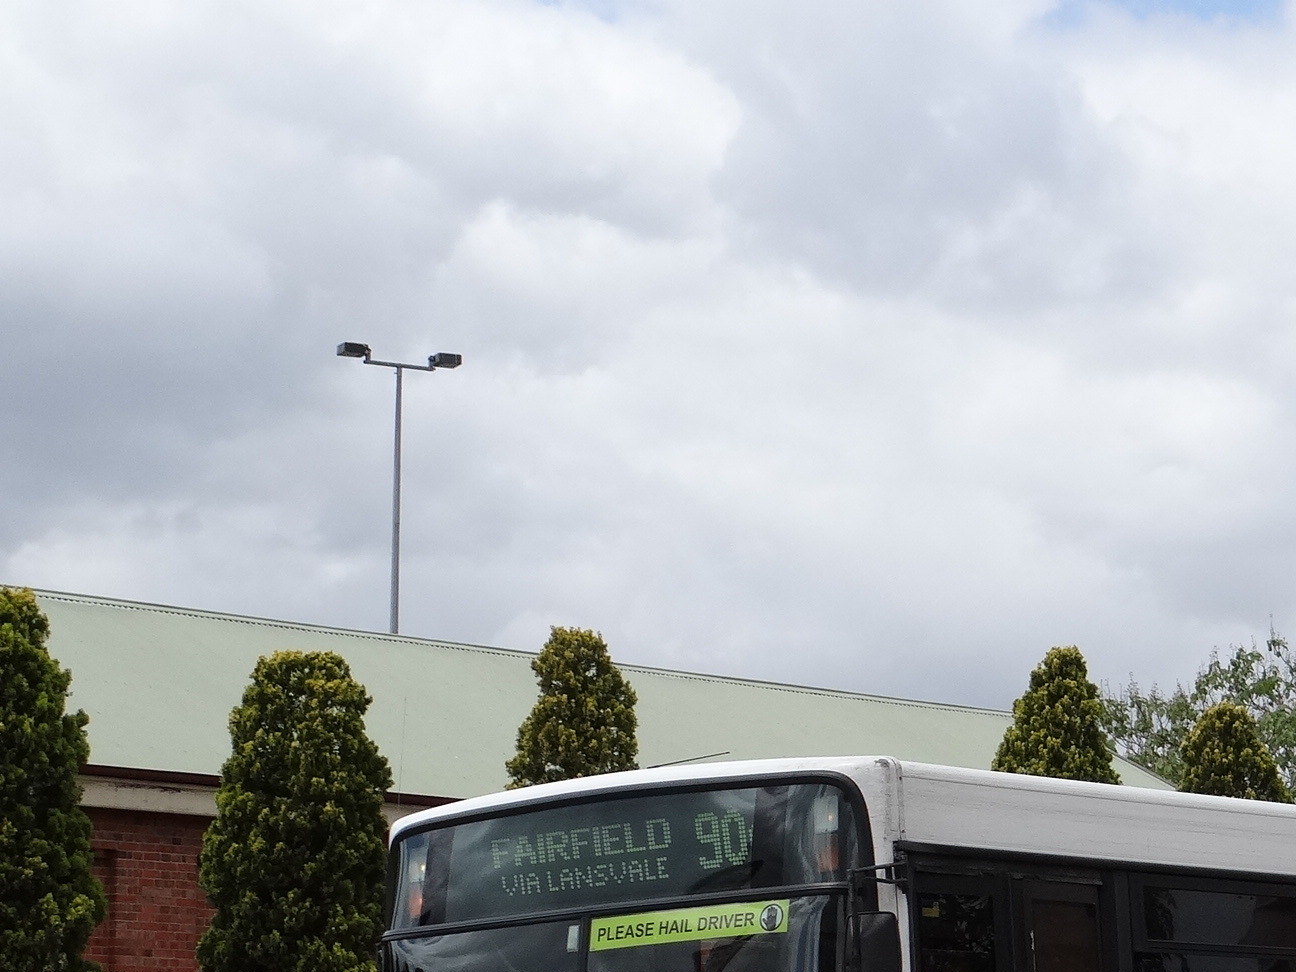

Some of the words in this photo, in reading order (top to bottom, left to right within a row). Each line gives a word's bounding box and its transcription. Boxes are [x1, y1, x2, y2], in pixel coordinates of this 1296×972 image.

[491, 818, 672, 869] FAIRFIELD
[694, 810, 753, 870] 90
[501, 872, 542, 896] VIA
[547, 857, 669, 893] LANSVALE
[597, 922, 655, 942] PLEASE
[658, 918, 693, 936] HAIL
[697, 912, 755, 931] DRIVER
